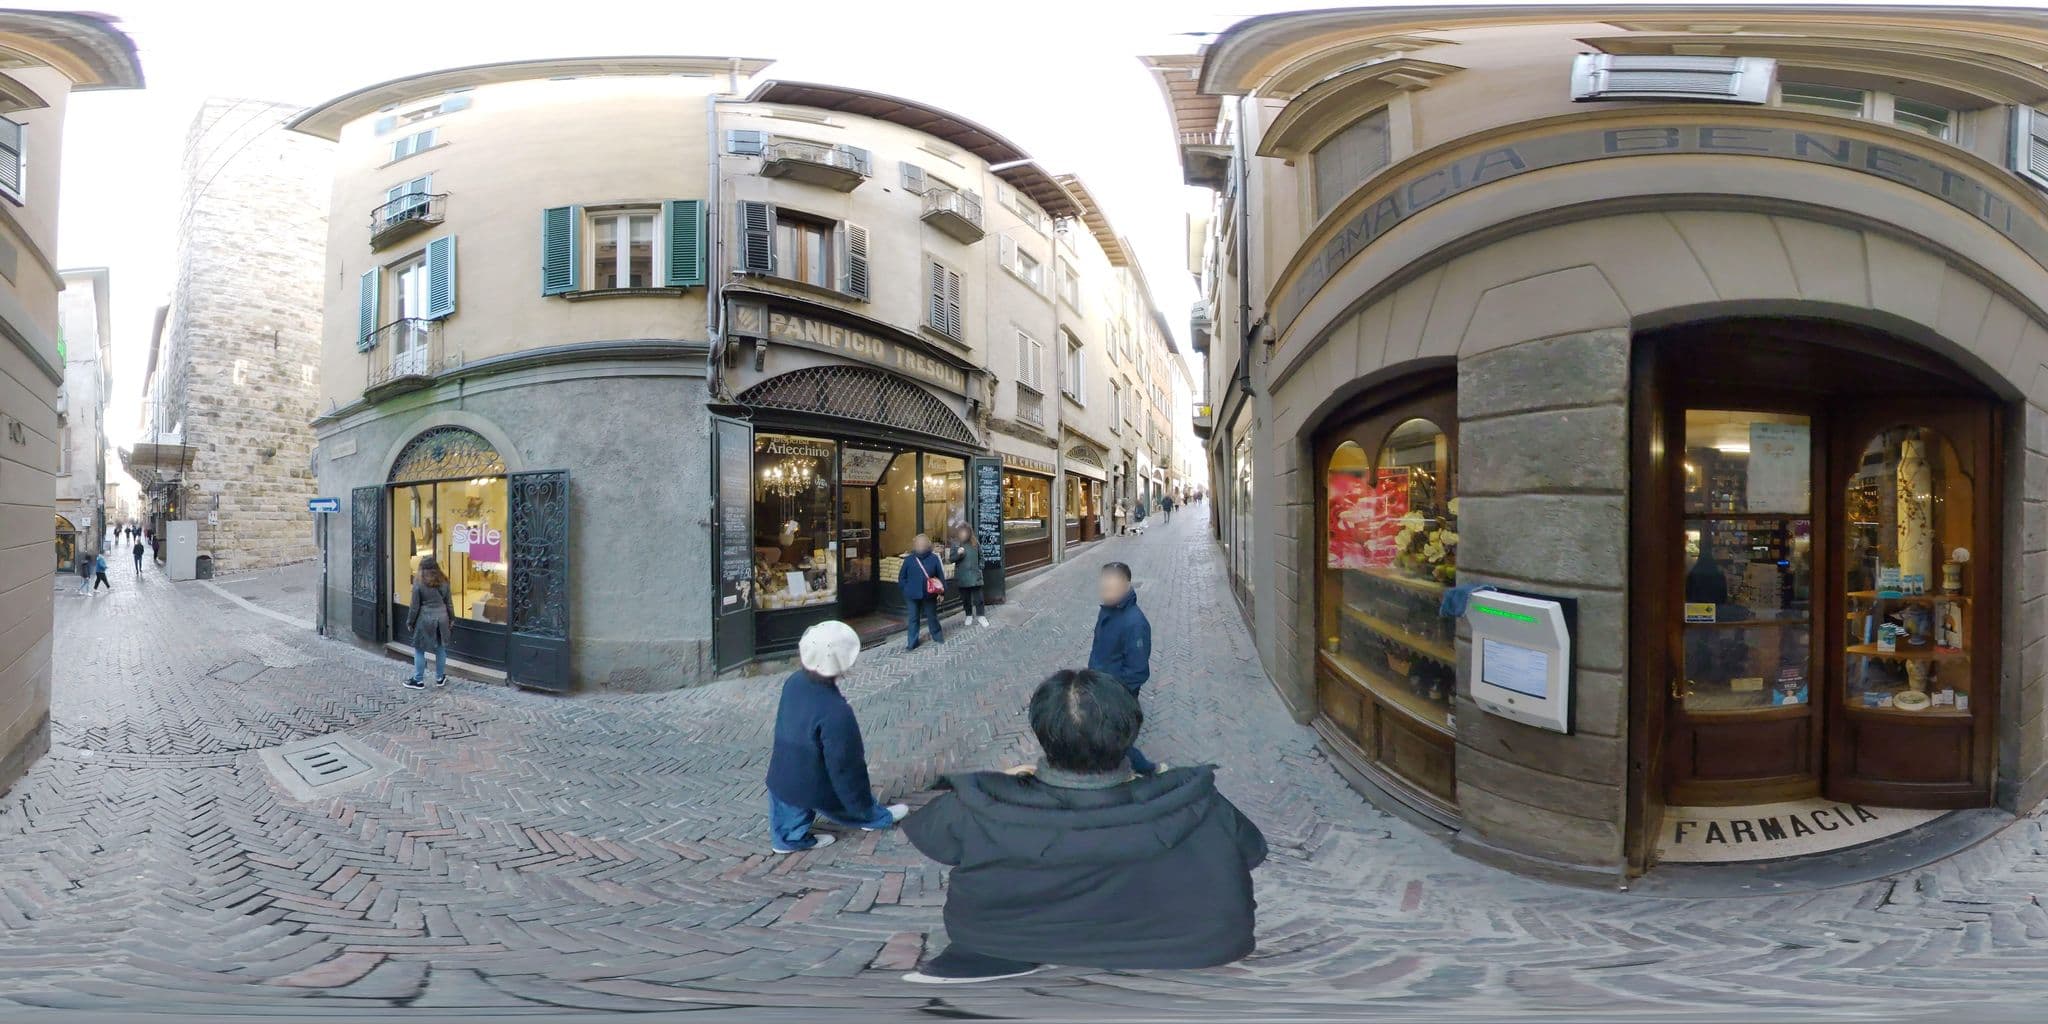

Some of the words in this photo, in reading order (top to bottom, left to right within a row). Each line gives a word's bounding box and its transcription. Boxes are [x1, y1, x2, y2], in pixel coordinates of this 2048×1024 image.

[1296, 147, 1527, 298] FARMACIA
[1604, 126, 2013, 233] BENETTI
[770, 313, 886, 362] PANIFICIO
[894, 345, 966, 388] TRESOLDI
[766, 442, 830, 457] Arlecchino
[453, 523, 501, 546] Sale
[1674, 805, 1879, 844] FARMACIA
